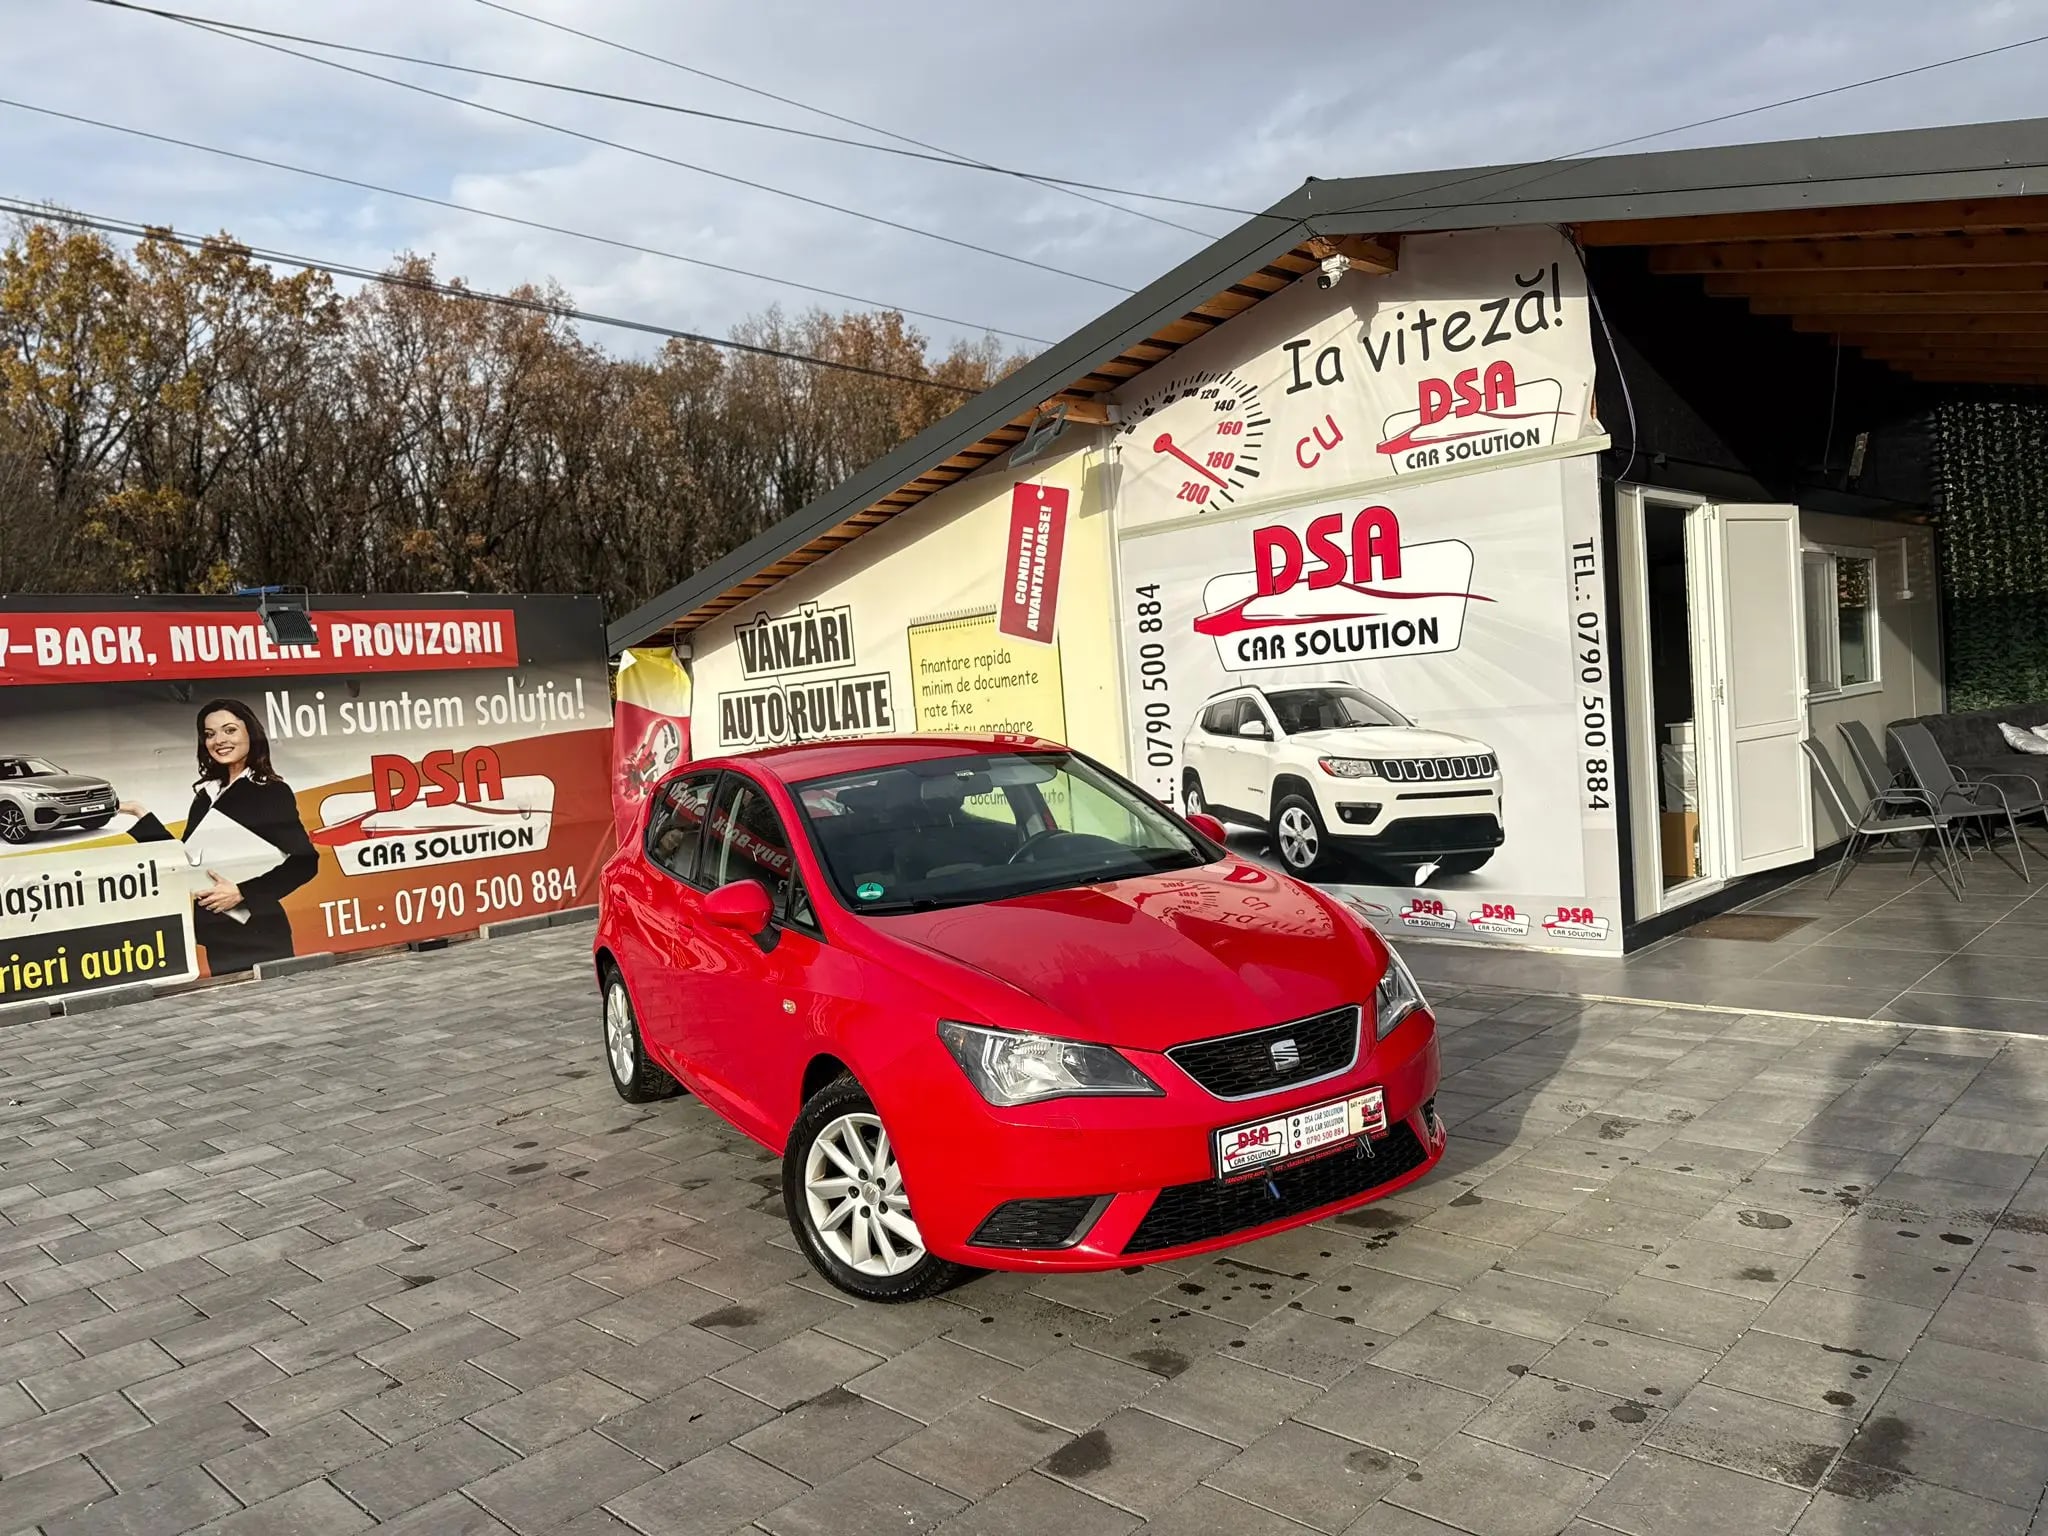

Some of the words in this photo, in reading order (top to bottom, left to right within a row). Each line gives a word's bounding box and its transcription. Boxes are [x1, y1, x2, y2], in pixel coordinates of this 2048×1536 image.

[1282, 339, 1345, 394] Ia
[1362, 262, 1563, 373] viteză!
[1200, 389, 1219, 400] 120
[1213, 399, 1236, 412] 140
[1418, 360, 1517, 425] DSA
[1216, 421, 1243, 436] 160
[1296, 414, 1344, 469] cu
[1406, 447, 1440, 469] CAR
[1446, 427, 1541, 464] SOLUTION
[1206, 451, 1235, 470] 180
[1176, 481, 1211, 504] 200
[1014, 526, 1034, 605] CONDITII
[1026, 505, 1052, 632] AVANTAJOASE!
[1253, 505, 1402, 597] DSA
[1572, 536, 1596, 601] TEL.:
[1135, 583, 1163, 635] 884
[331, 621, 503, 657] PROVIZORII
[738, 609, 851, 674] VÂNZĂRI
[1238, 633, 1285, 662] CAR
[1295, 616, 1439, 658] SOLUTION
[1577, 611, 1602, 683] 0790
[920, 656, 970, 675] finantare
[974, 648, 1011, 671] rapida
[1139, 642, 1168, 692] 500
[922, 680, 953, 697] minim
[956, 676, 971, 692] de
[974, 670, 1039, 690] documente
[265, 691, 328, 740] Noi
[339, 691, 464, 734] suntem
[476, 676, 585, 730] soluția!
[722, 691, 788, 741] AUTO
[790, 679, 890, 734] RULATE
[924, 704, 948, 718] rate
[951, 699, 973, 717] fixe
[1582, 695, 1606, 748] 500
[1144, 702, 1174, 767] 0790
[371, 746, 504, 812] DSA
[1586, 758, 1610, 811] 884
[358, 842, 406, 868] CAR
[415, 827, 534, 861] SOLUTION
[98, 860, 160, 903] noi!
[319, 898, 387, 938] TEL.:
[395, 882, 465, 925] 0790
[475, 873, 523, 913] 500
[531, 865, 577, 903] 884
[1412, 898, 1444, 916] DSA
[1420, 919, 1451, 929] SOLUTION
[1482, 903, 1515, 920] DSA
[1557, 907, 1594, 924] DSA
[1491, 924, 1524, 934] SOLUTION
[1567, 929, 1602, 938] SOLUTION
[81, 930, 167, 981] auto!
[1306, 1135, 1321, 1146] 0790
[1322, 1131, 1333, 1142] 500
[1333, 1127, 1345, 1137] 884
[1314, 1111, 1323, 1120] CAR
[1314, 1122, 1323, 1131] CAR
[1233, 1155, 1246, 1166] CAR
[1246, 1148, 1277, 1162] SOLUTION
[1237, 1126, 1269, 1149] DSA
